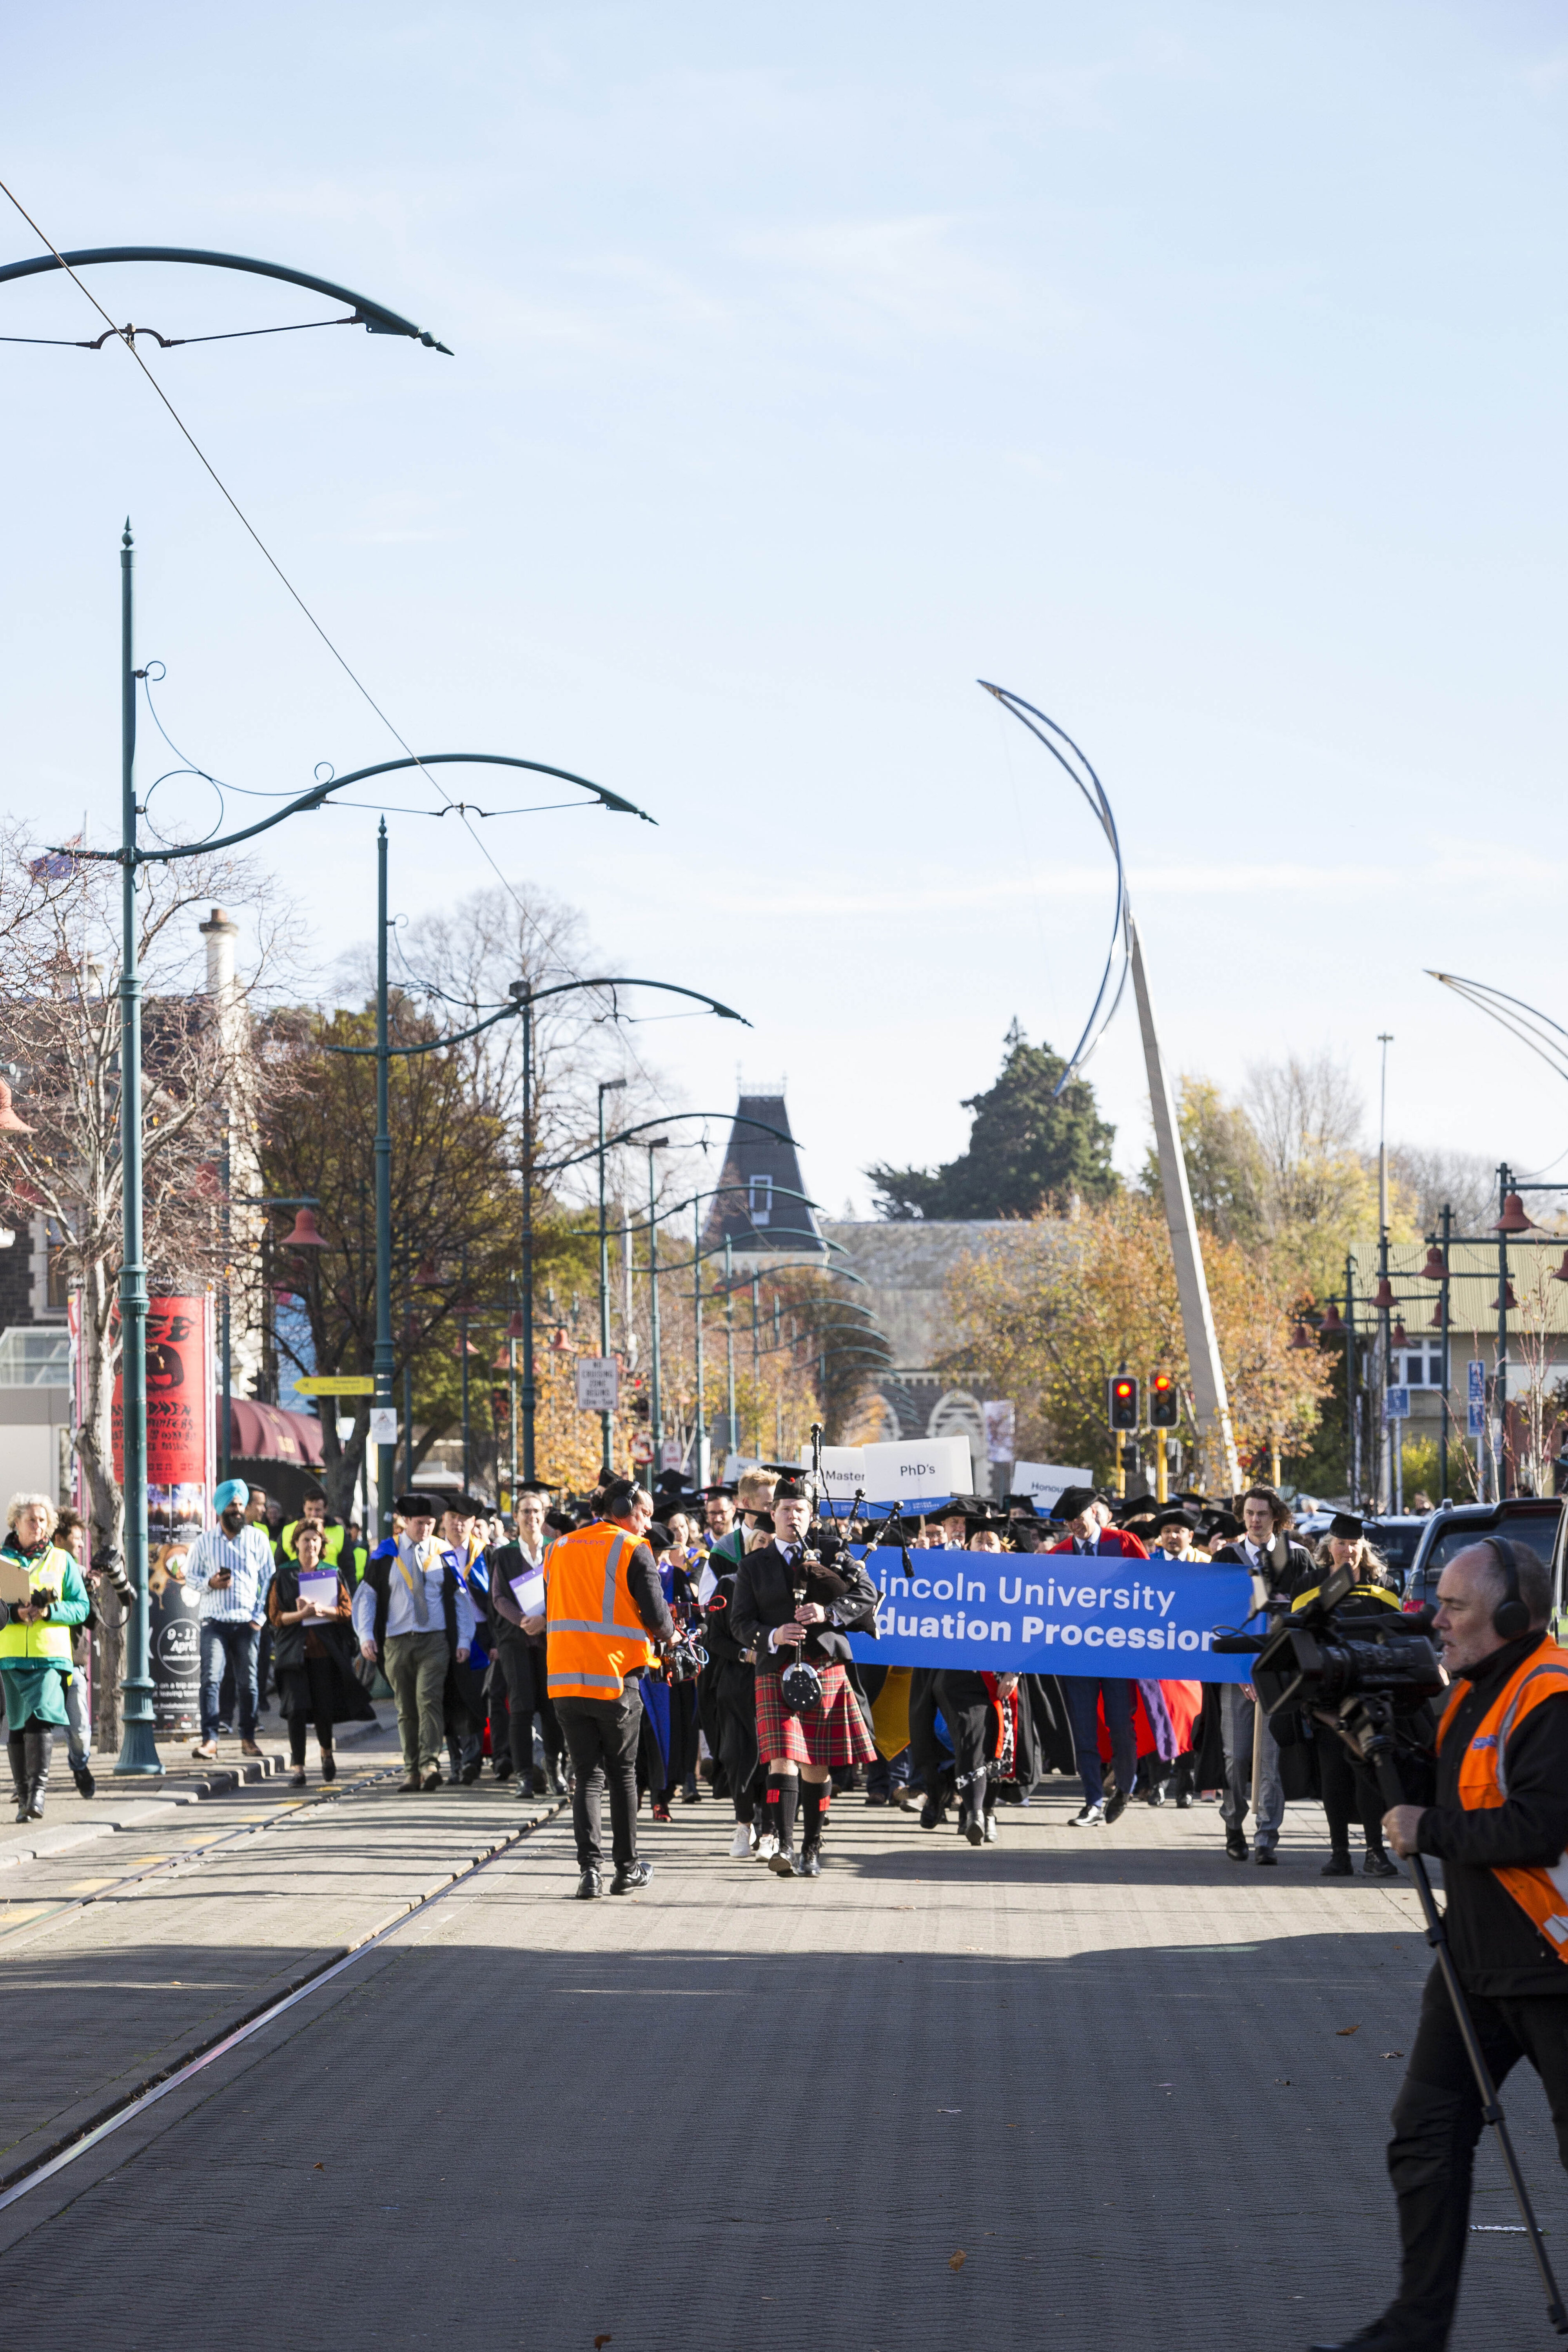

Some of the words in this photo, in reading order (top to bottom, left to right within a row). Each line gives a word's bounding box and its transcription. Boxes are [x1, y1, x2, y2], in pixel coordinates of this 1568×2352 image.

[826, 1471, 864, 1481] Master
[900, 1464, 935, 1476] PhD's
[1031, 1481, 1064, 1493] Honou
[880, 1569, 985, 1602] incoln
[999, 1576, 1176, 1617] University
[876, 1607, 1011, 1642] duation
[167, 1628, 176, 1640] 9
[184, 1628, 197, 1640] 11
[170, 1640, 197, 1654] April
